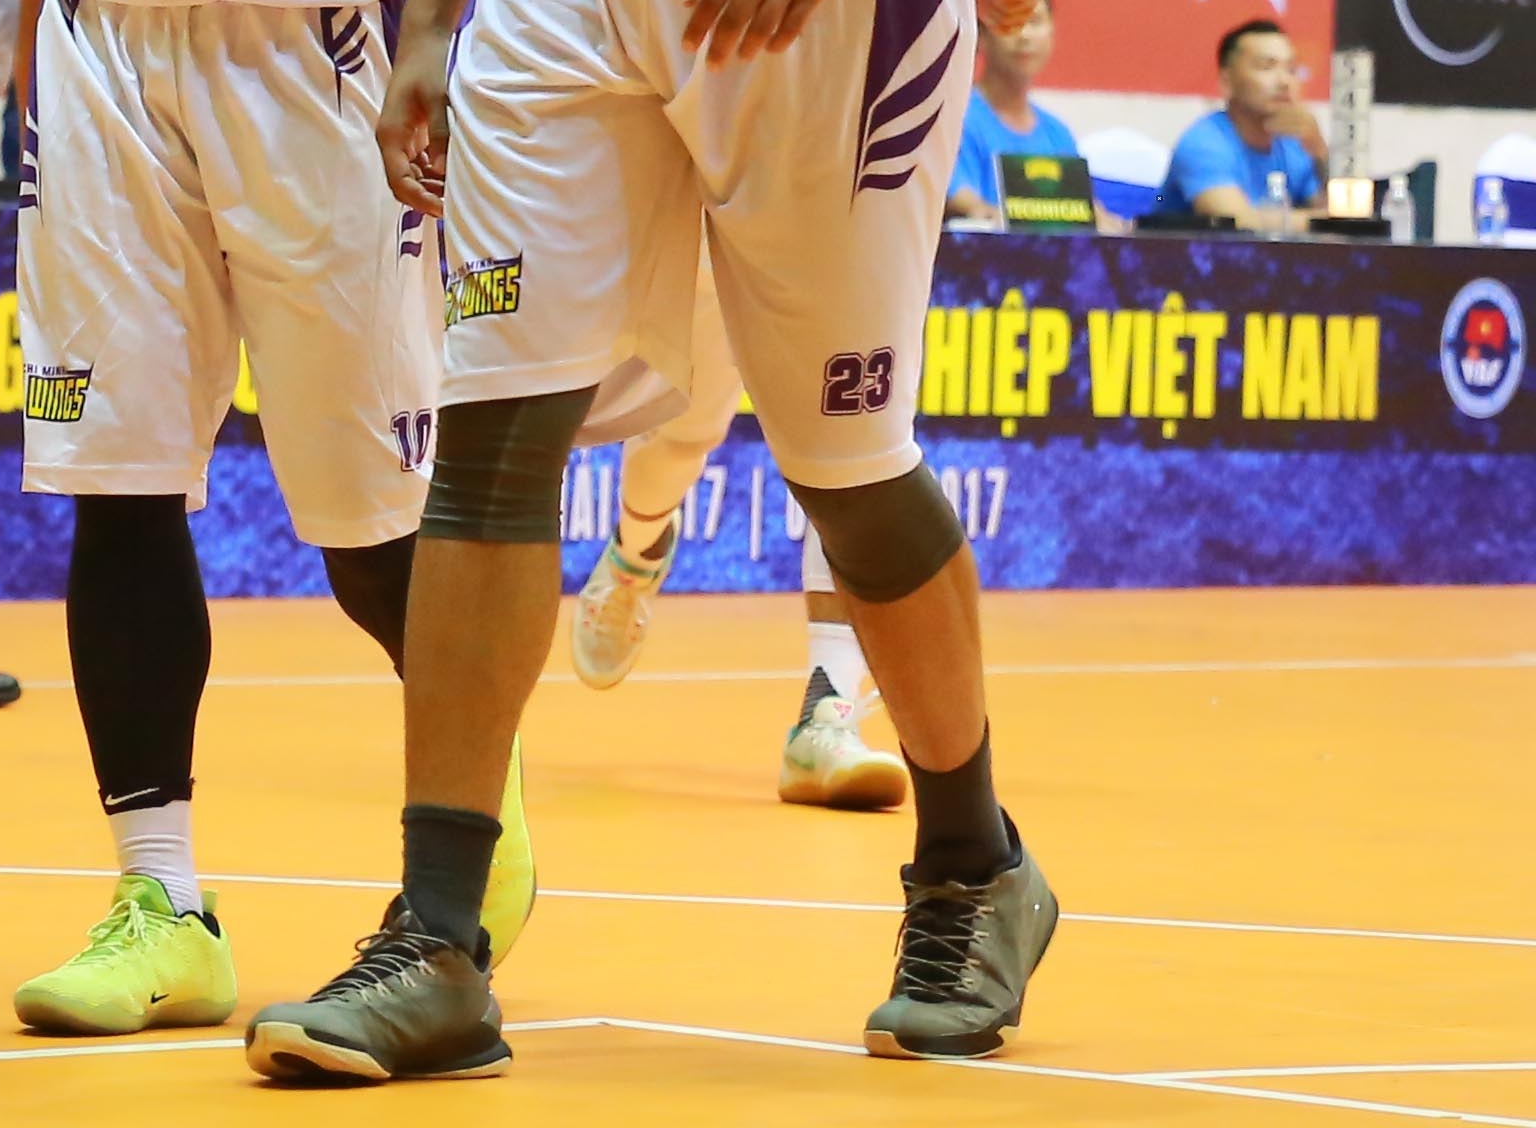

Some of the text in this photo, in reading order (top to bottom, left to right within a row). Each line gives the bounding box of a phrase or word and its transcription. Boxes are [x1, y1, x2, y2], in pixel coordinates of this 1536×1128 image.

[25, 374, 92, 424] WINGS
[821, 345, 896, 417] 23
[921, 287, 1382, 441] HIỆP VIỆT NAM
[390, 409, 433, 473] 10
[683, 466, 729, 541] 17
